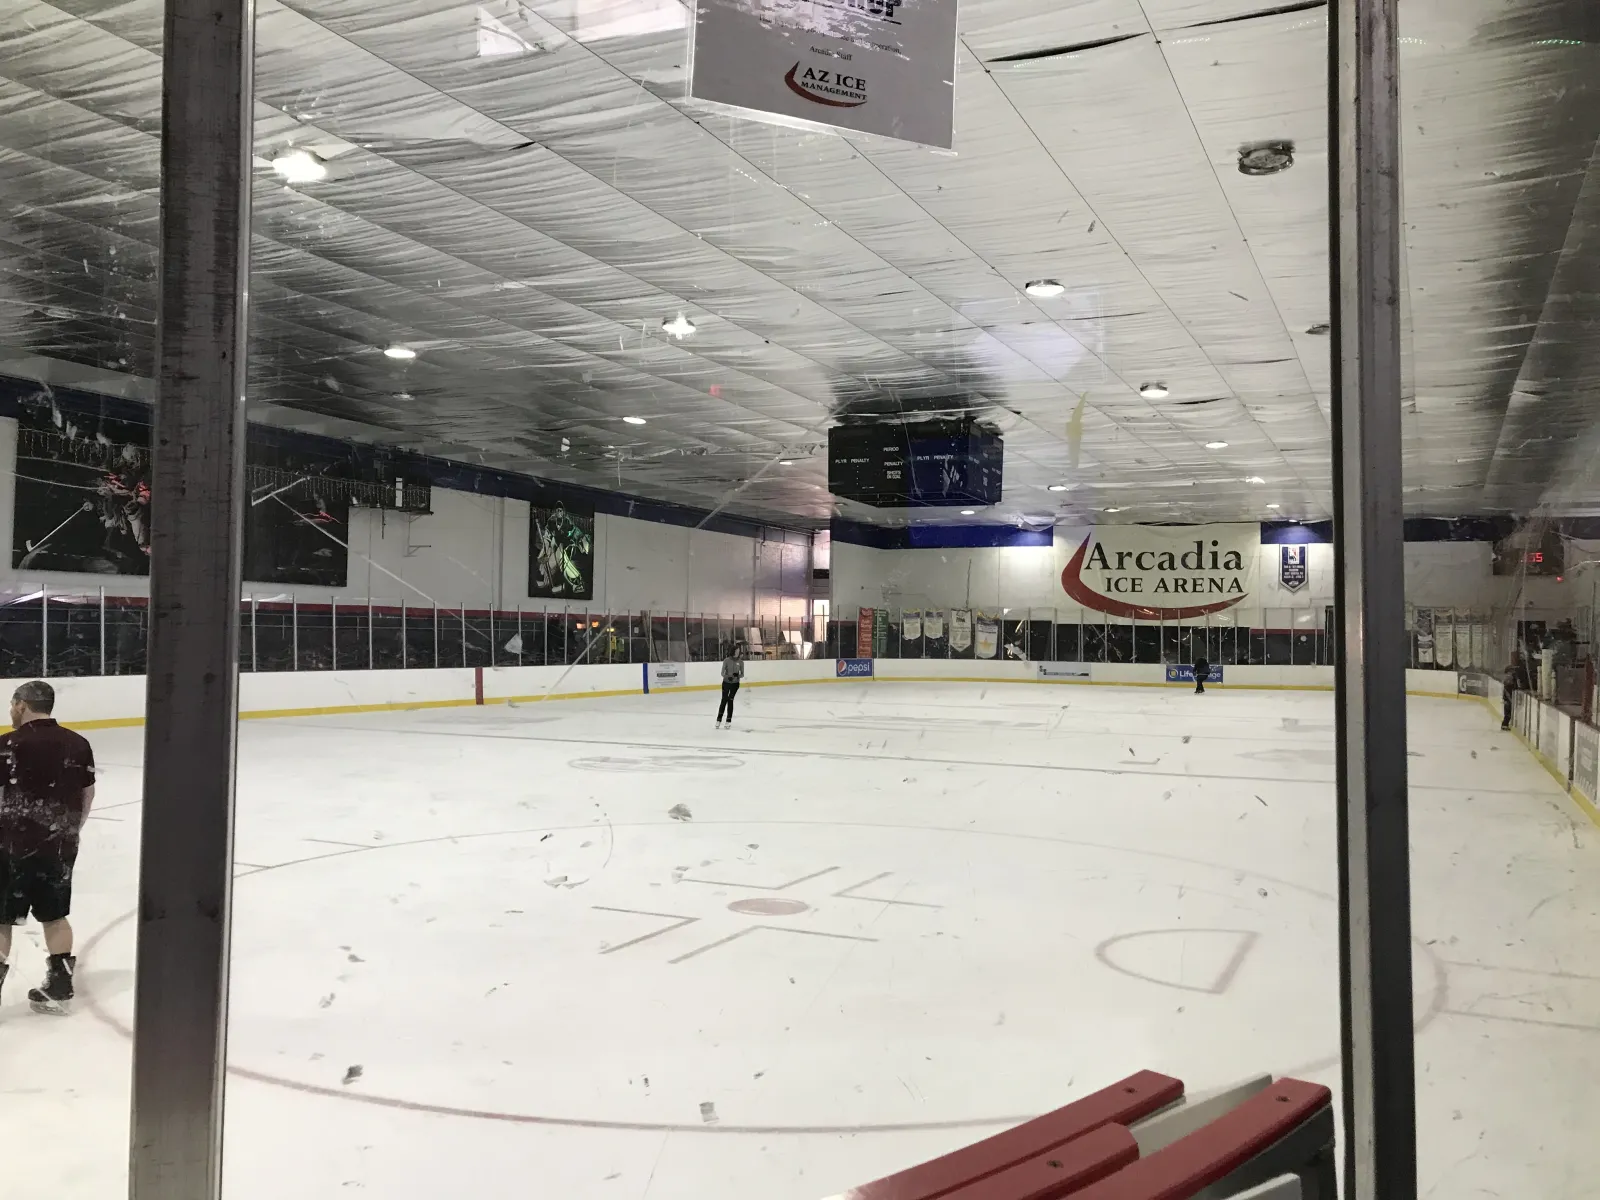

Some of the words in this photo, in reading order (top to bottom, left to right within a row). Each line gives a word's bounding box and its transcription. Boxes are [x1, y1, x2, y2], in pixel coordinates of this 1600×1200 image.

[803, 67, 830, 83] AZ
[835, 73, 866, 91] ICE
[801, 81, 867, 101] MANAGEMENT
[1084, 540, 1244, 571] Arcadia
[1105, 577, 1143, 593] ICE
[1153, 577, 1244, 593] ARENA
[847, 662, 870, 673] pepsi
